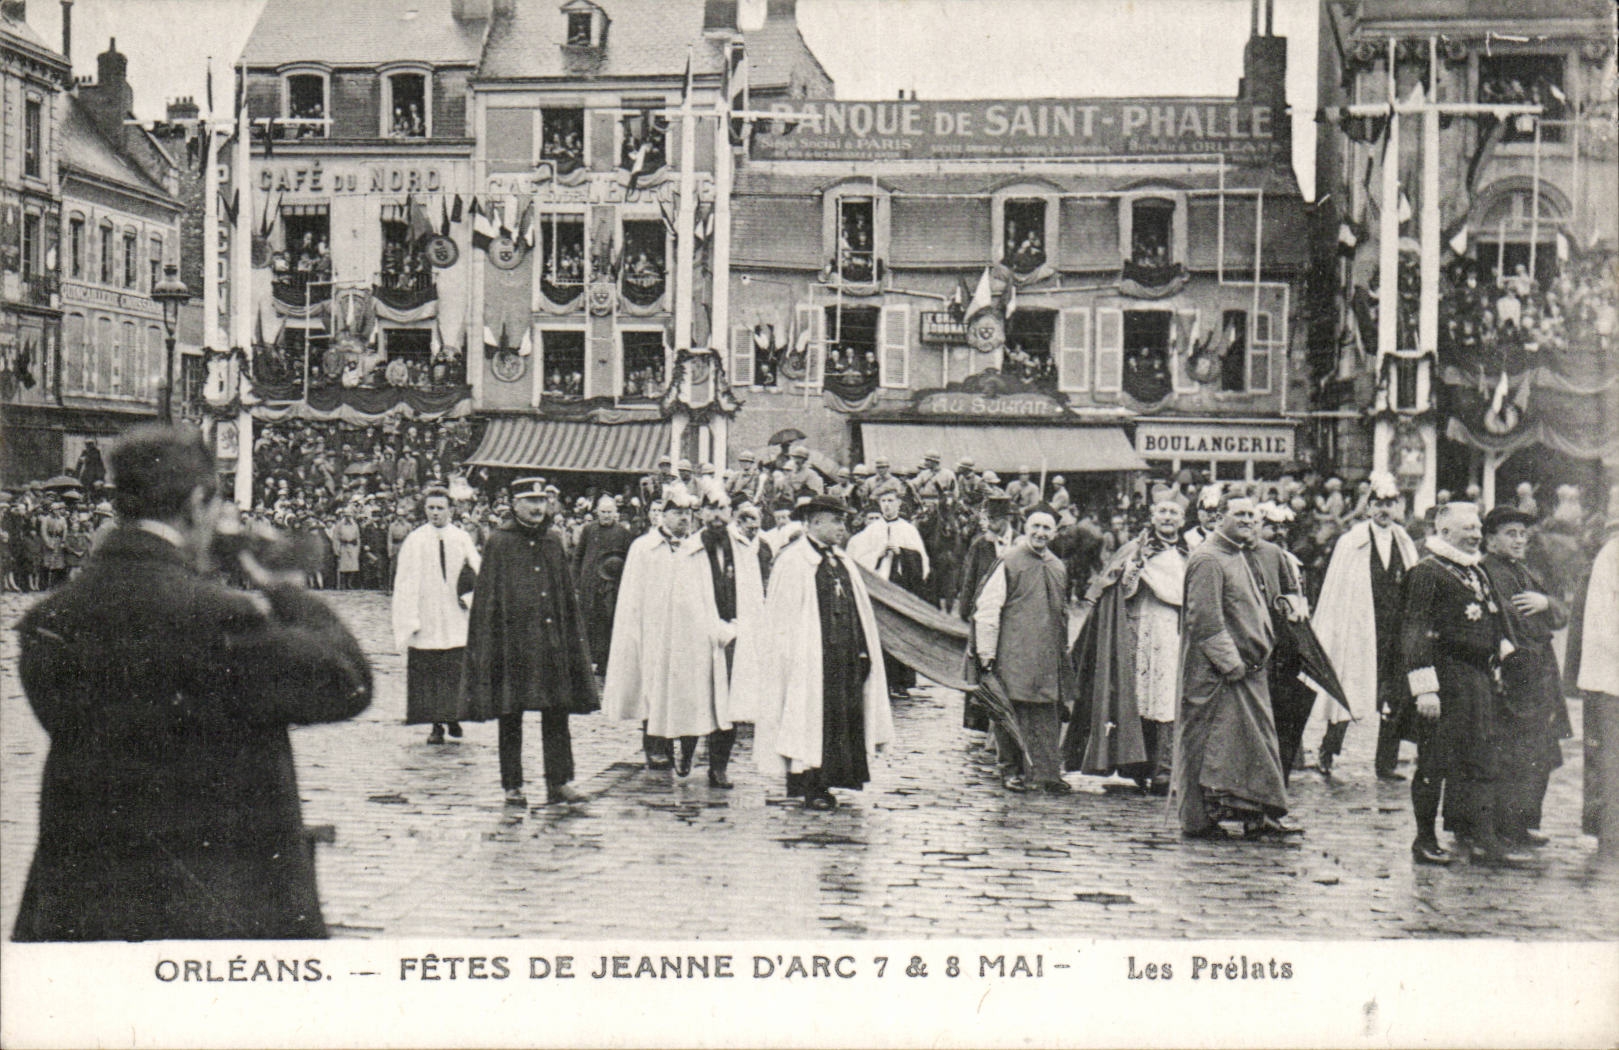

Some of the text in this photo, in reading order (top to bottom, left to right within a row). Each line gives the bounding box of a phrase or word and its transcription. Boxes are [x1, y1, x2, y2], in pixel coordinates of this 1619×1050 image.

[934, 111, 973, 136] DE
[857, 139, 912, 150] PARIS
[260, 159, 441, 192] CAFÉ DU NORD
[1145, 436, 1286, 453] BOULANGERIE
